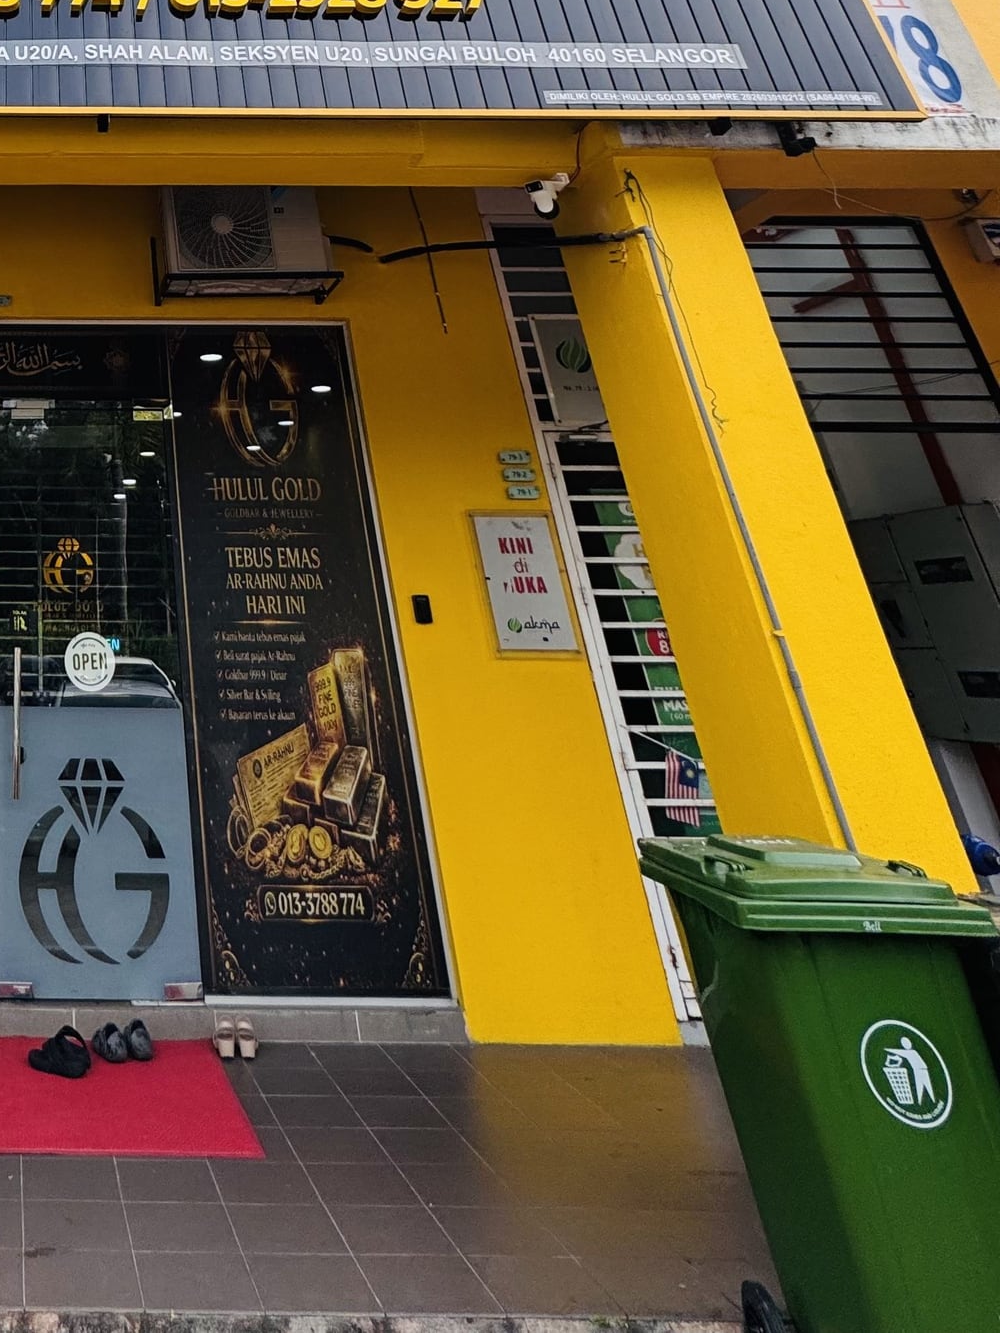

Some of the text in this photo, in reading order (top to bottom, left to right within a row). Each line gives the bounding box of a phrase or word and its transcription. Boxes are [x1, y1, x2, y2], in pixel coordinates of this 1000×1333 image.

[15, 44, 78, 64] U20/A,
[84, 44, 145, 63] SHAH
[148, 44, 213, 64] ALAM,
[219, 45, 320, 63] SEKSYEN
[324, 46, 369, 64] U20,
[373, 46, 458, 64] SUNGAI
[463, 47, 537, 64] BULOH
[548, 48, 606, 64] 40160
[611, 47, 734, 65] SELANGOR
[549, 93, 589, 101] DIMILIKI
[621, 93, 654, 101] HULUL
[655, 93, 685, 102] GOLD
[702, 94, 739, 102] EMPIRE
[213, 477, 322, 502] HULUL GOLD
[498, 537, 533, 554] KINI
[225, 546, 321, 568] TEBUS EMAS
[514, 557, 529, 573] di
[226, 573, 324, 591] AR-RAHNU ANDA
[246, 595, 306, 615] HARI INI
[72, 652, 108, 671] OPEN
[278, 892, 365, 915] 013-3788 774
